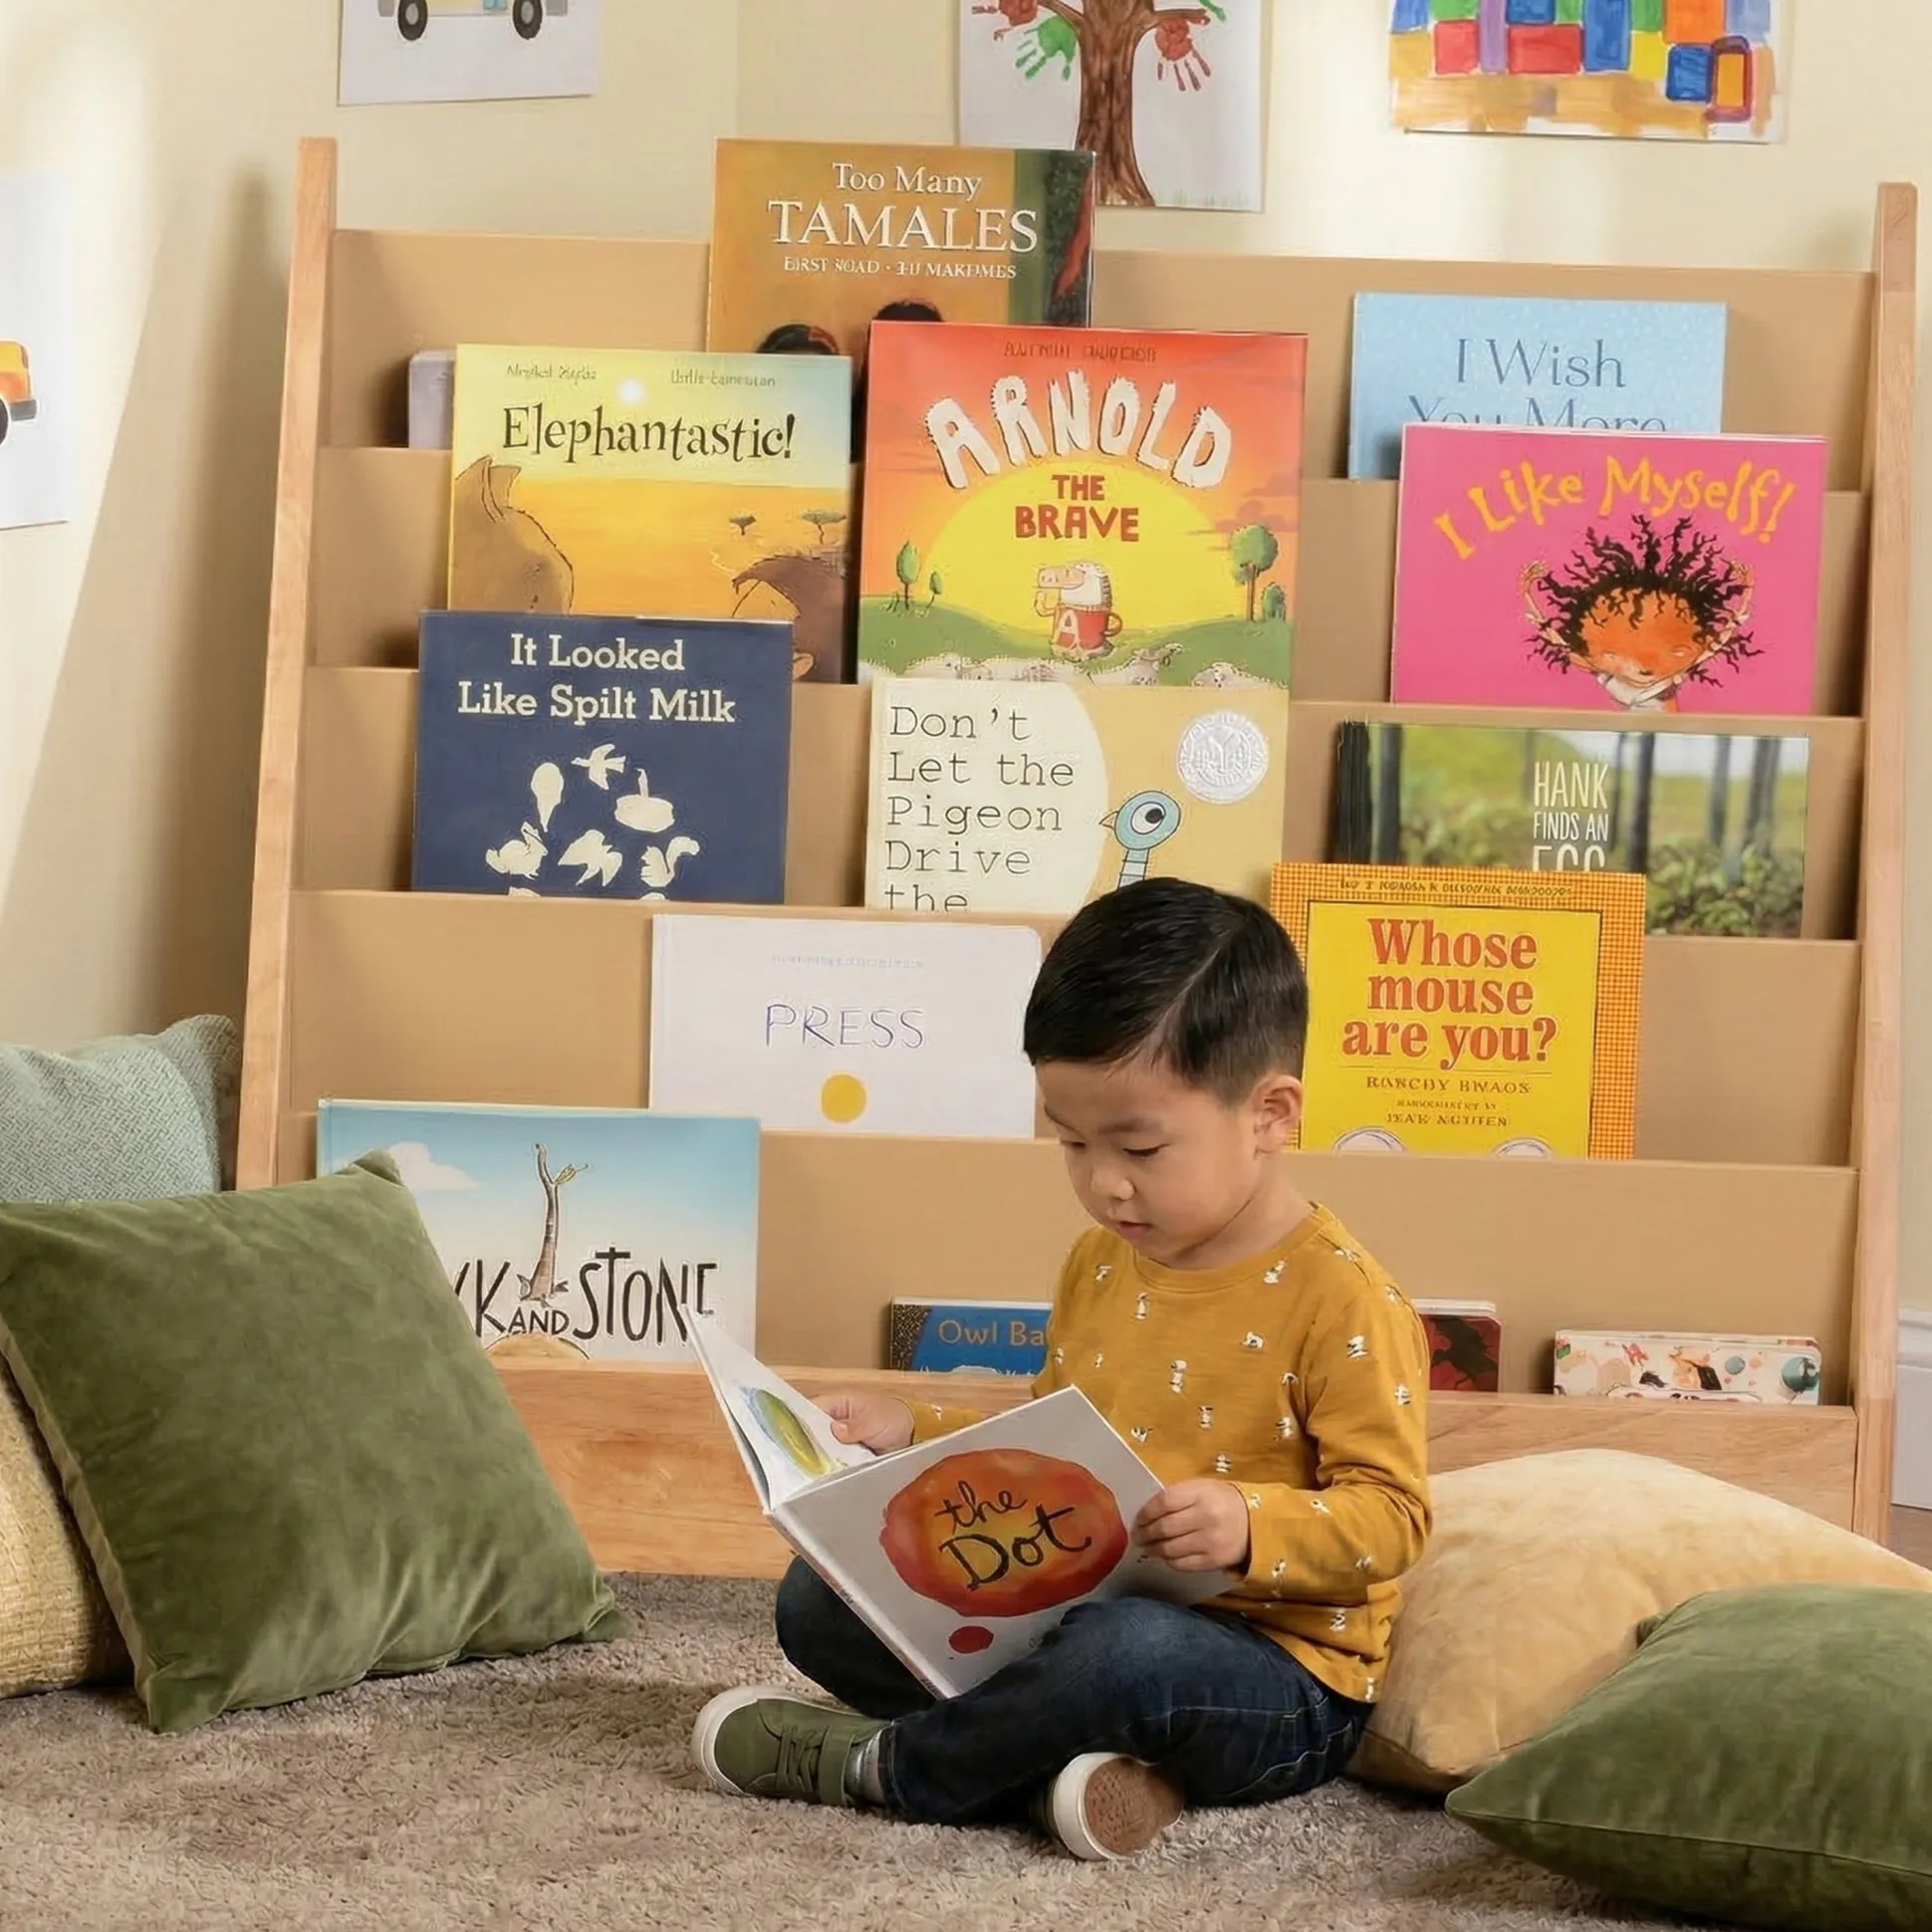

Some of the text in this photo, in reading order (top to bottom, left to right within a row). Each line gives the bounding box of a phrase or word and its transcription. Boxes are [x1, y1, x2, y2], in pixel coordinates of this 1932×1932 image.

[833, 162, 982, 201] Too Many
[768, 198, 1038, 253] TAMALES
[1457, 339, 1625, 388] I Wish
[503, 402, 796, 463] Elephantastic!
[925, 368, 1232, 489] ARNOLD
[1052, 474, 1105, 501] THE
[1434, 455, 1796, 560] I Like Myself!
[1015, 506, 1139, 542] BRAVE
[511, 633, 685, 671] It Looked
[458, 681, 737, 726] Like Spilt Milk
[889, 706, 1029, 740] Don't
[887, 752, 1075, 787] Let the
[1534, 761, 1609, 810] HANK
[886, 795, 1062, 835] Pigeon
[1534, 812, 1609, 843] FINDS AN
[884, 840, 1032, 875] Drive
[884, 883, 969, 912] the
[1367, 918, 1538, 970] Whose
[1366, 974, 1535, 1016] mouse
[766, 1003, 925, 1049] PRESS
[1341, 1016, 1558, 1071] are you?
[508, 1310, 571, 1335] AND
[938, 1320, 999, 1343] Owl
[934, 1480, 1028, 1535] the
[938, 1504, 1092, 1591] Dot
